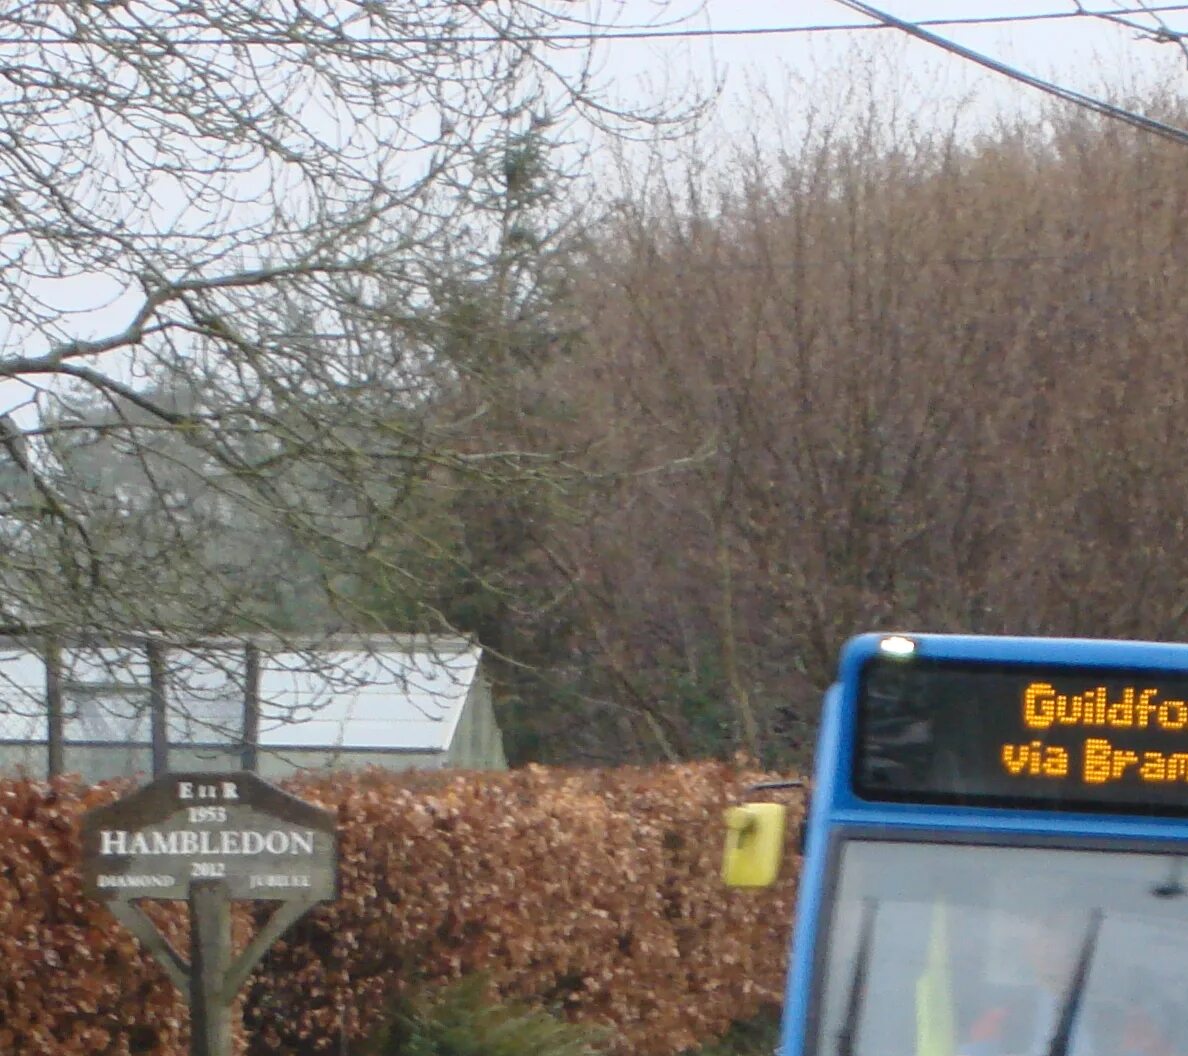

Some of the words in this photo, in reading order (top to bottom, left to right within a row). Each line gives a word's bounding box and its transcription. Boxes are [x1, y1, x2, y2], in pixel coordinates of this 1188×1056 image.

[1002, 741, 1068, 776] via
[177, 781, 194, 799] E
[222, 781, 239, 799] R
[187, 806, 228, 823] 1953
[99, 830, 314, 855] HAMBLEDON
[190, 862, 225, 877] 2012
[96, 874, 176, 888] DIAMOND
